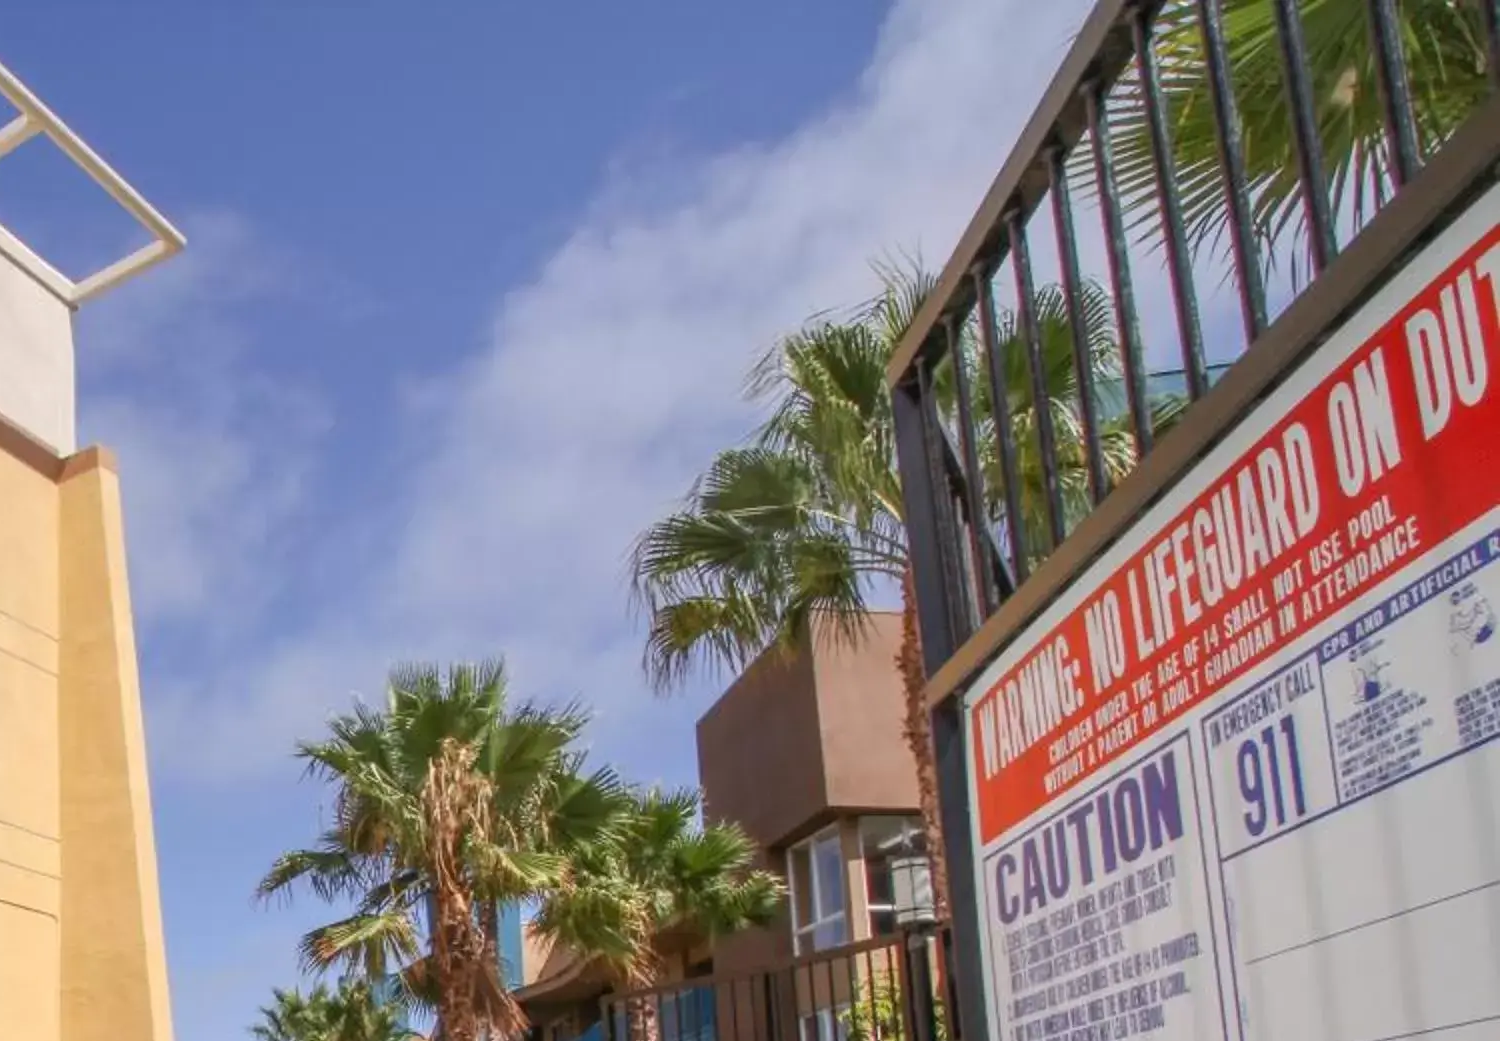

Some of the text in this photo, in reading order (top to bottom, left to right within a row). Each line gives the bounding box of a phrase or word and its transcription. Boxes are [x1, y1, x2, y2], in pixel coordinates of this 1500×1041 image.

[979, 634, 1084, 780] WARNING:
[1085, 589, 1126, 695] NO
[1128, 422, 1320, 661] LIFEGUARD
[1328, 347, 1402, 497] ON
[1049, 494, 1397, 766] CHILDREN UNDER THE AGE OF 14 SHALL NOT USE POOL
[1322, 634, 1350, 658] CPR
[1354, 610, 1384, 638] AND
[1390, 547, 1482, 616] ARTIFICIAL
[1043, 750, 1085, 796] WITHOUT
[1087, 743, 1096, 766] A
[1097, 711, 1139, 760] PARENT
[1142, 700, 1158, 729] OR
[1161, 669, 1200, 717] ADULT
[1204, 614, 1276, 686] GUARDIAN
[1278, 600, 1297, 638] IN
[1302, 514, 1421, 622] ATTENDANCE
[1209, 660, 1317, 749] IN EMERGENCY CALL
[995, 752, 1184, 925] CAUTION
[1236, 714, 1305, 838] 911
